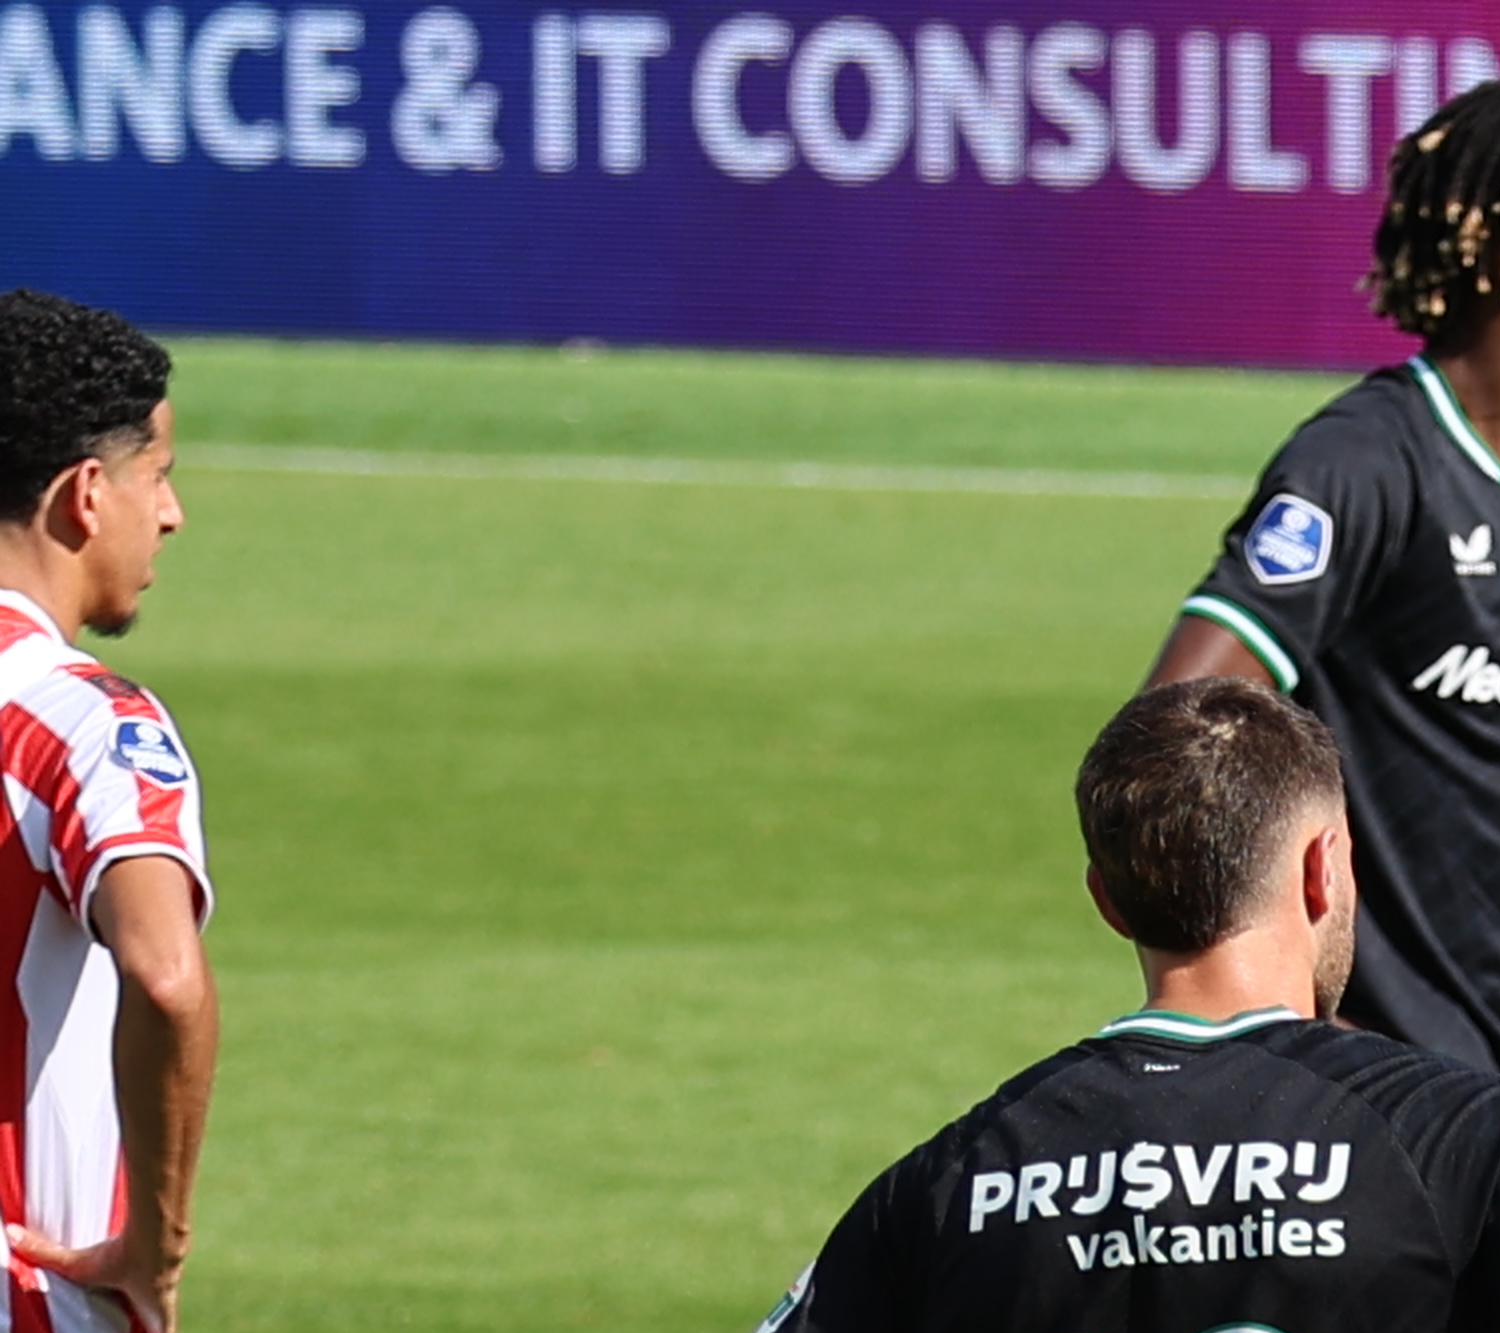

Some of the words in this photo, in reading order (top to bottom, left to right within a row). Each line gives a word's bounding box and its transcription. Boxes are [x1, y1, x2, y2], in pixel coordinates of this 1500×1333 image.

[391, 6, 504, 175] &
[532, 13, 671, 175] IT
[1066, 1207, 1346, 1272] vakanties
